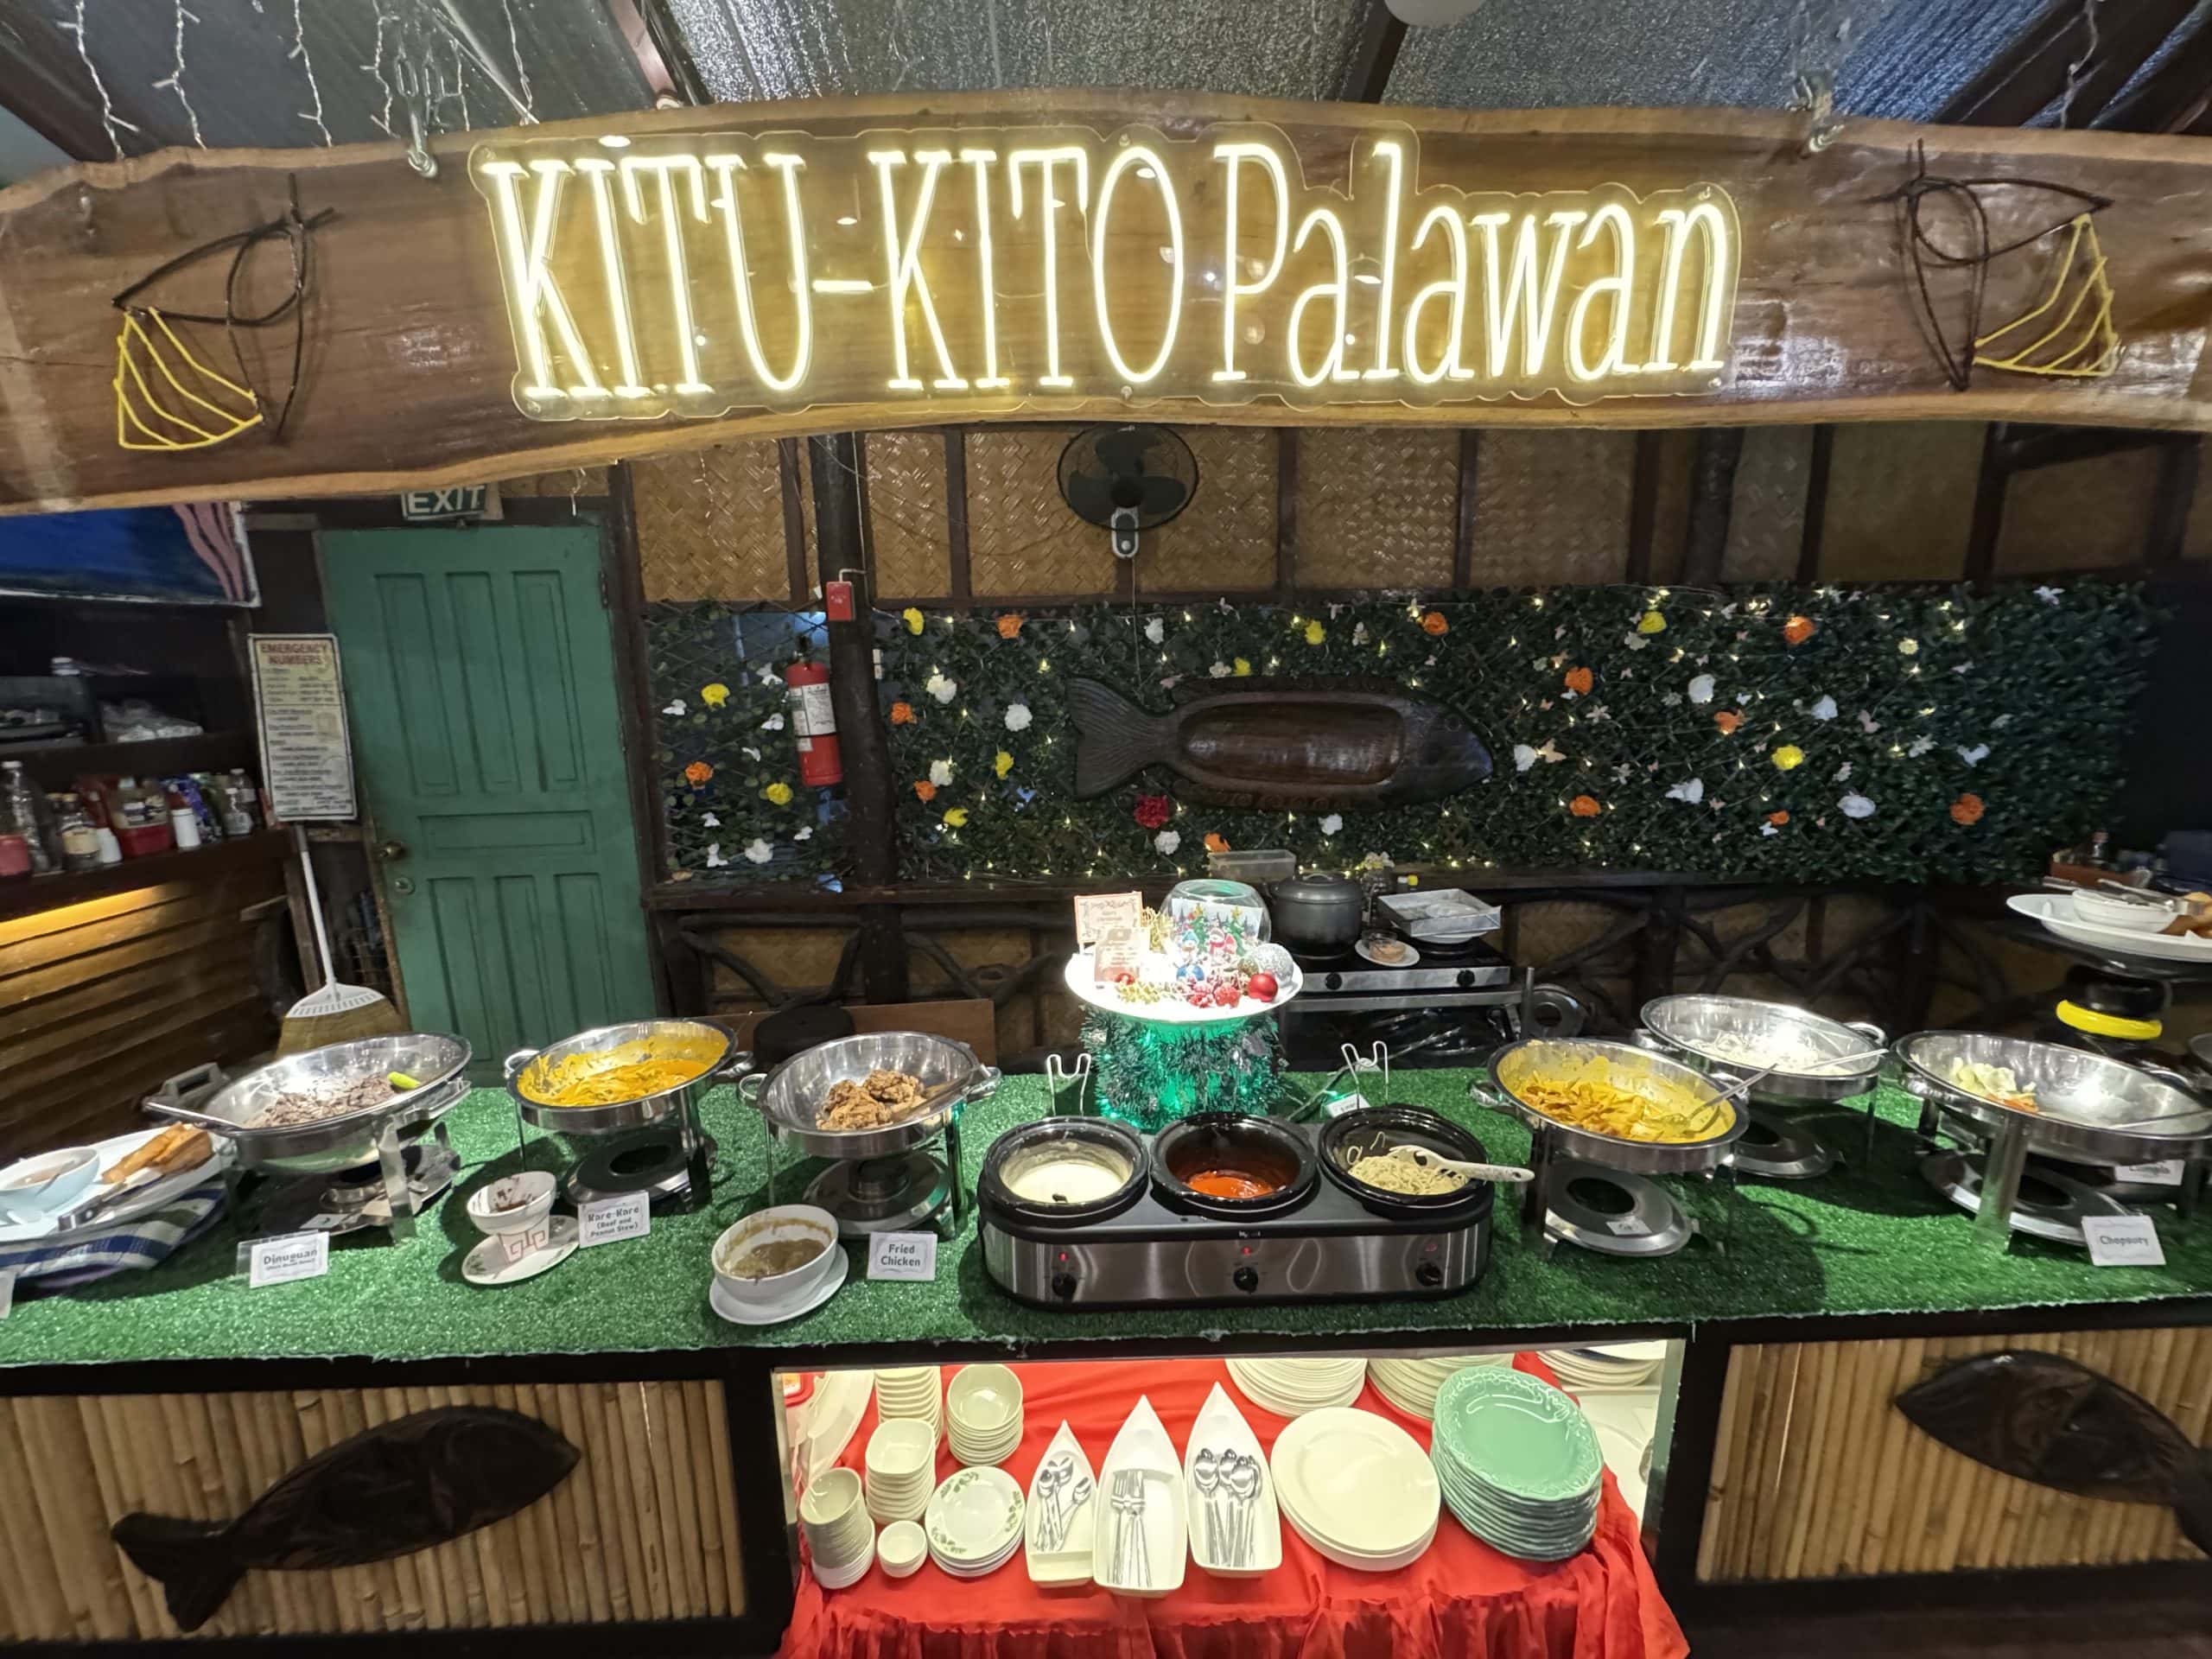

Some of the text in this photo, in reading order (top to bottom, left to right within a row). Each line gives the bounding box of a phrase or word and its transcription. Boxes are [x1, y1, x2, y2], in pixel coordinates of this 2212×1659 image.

[480, 142, 1727, 399] KITU-KITO Palawan
[407, 485, 486, 513] EXIT
[260, 643, 327, 654] EMERGENCY
[588, 1206, 639, 1223] Kare-Kare
[264, 1249, 318, 1266] Dinuguan
[888, 1243, 915, 1255] Fried
[880, 1255, 921, 1267] Chicken
